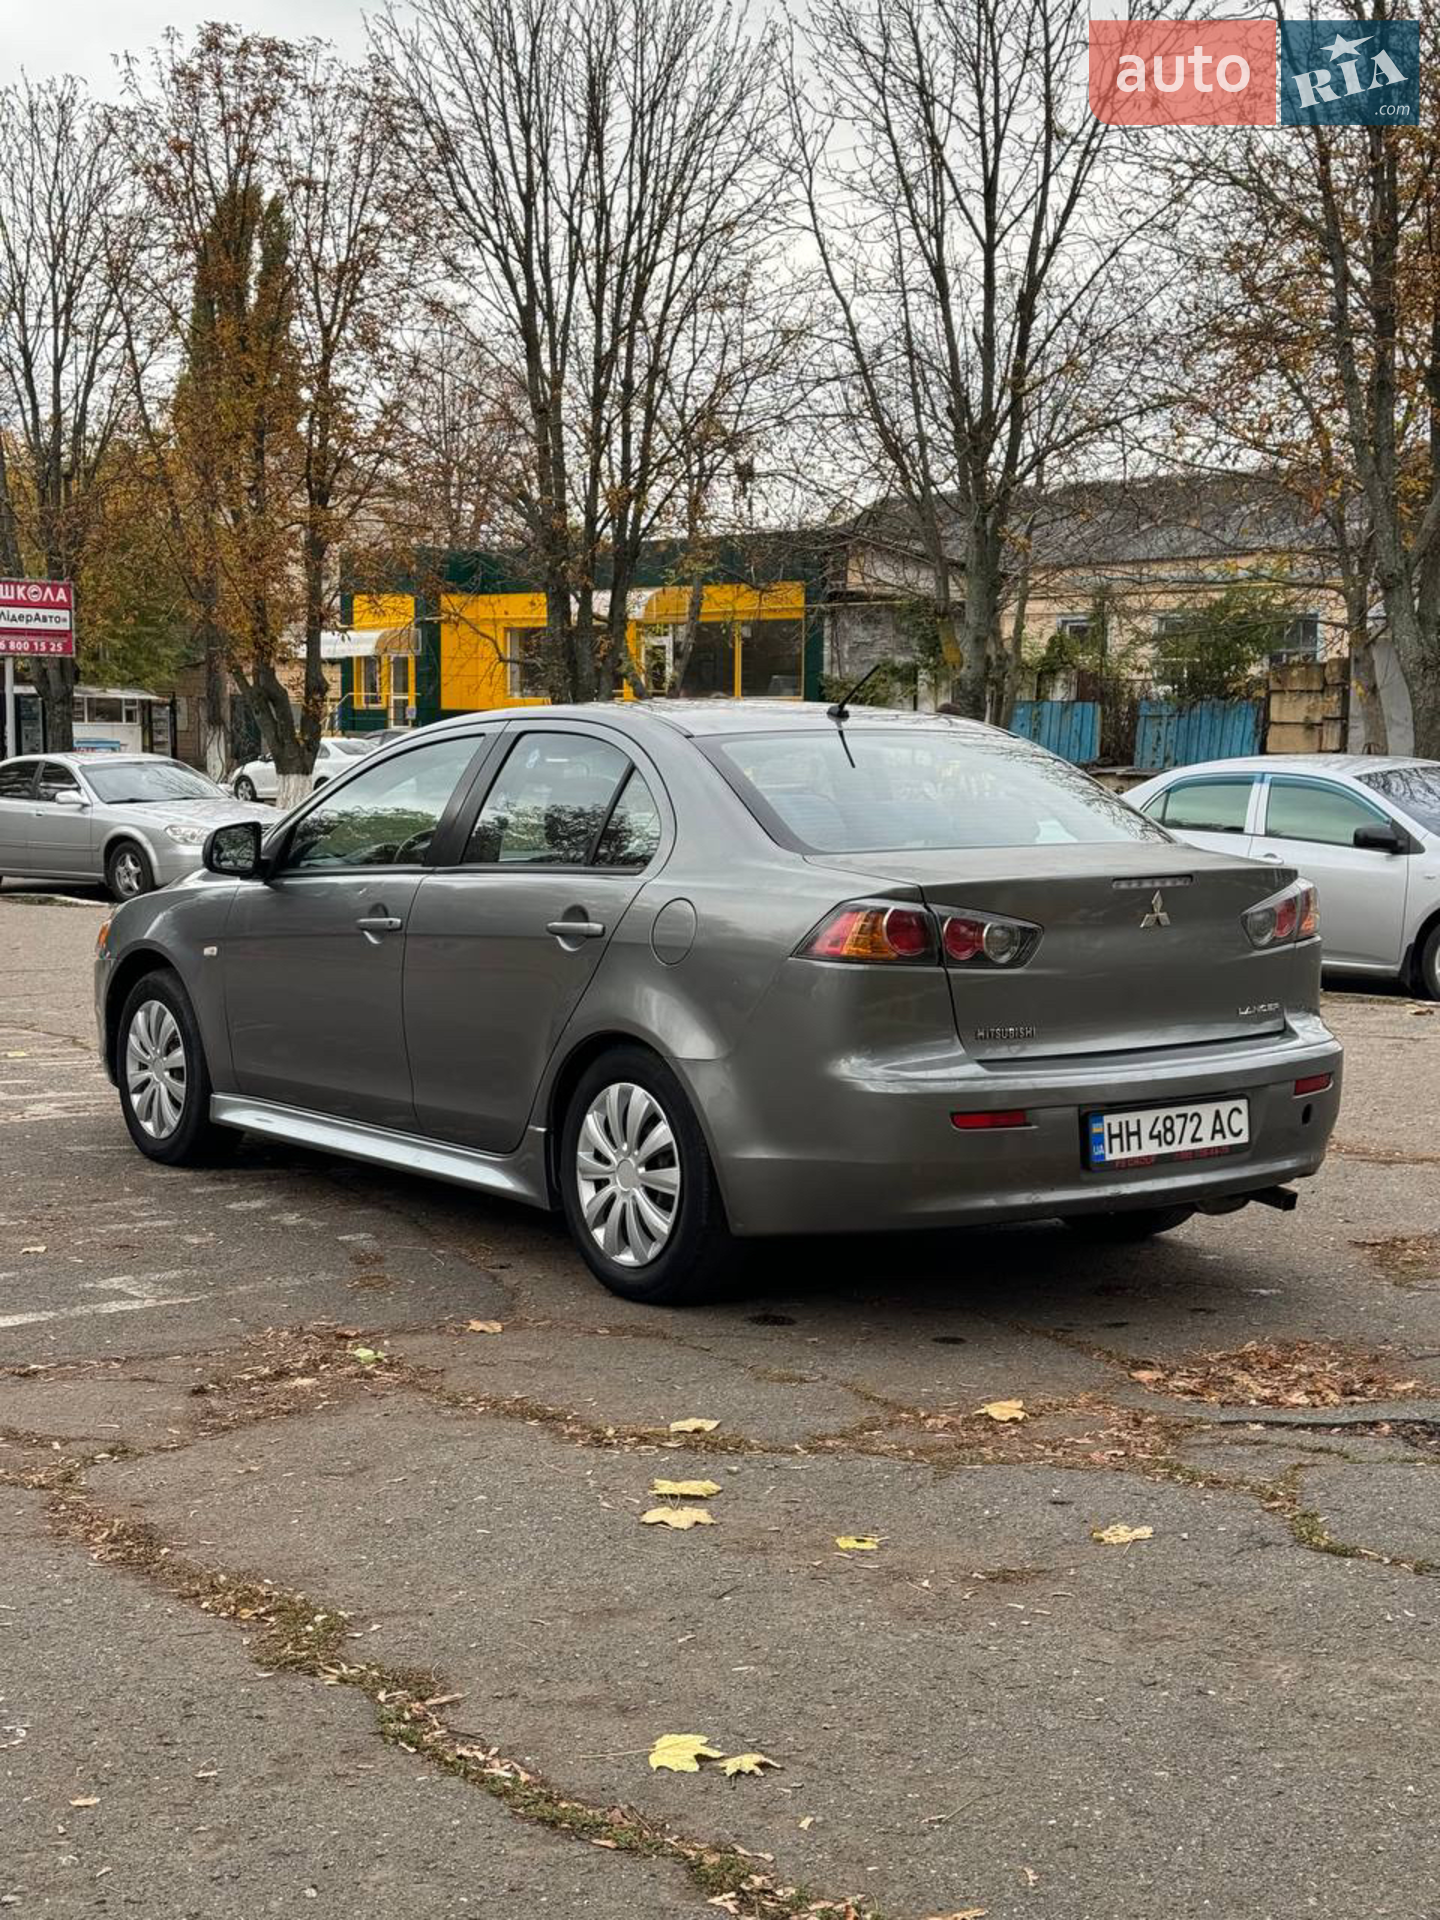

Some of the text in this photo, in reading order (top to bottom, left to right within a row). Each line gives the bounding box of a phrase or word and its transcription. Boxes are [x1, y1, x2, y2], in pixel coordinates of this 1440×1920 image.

[34, 642, 46, 651] 15
[50, 643, 63, 652] 25
[1107, 1107, 1243, 1154] HH 4872 AC
